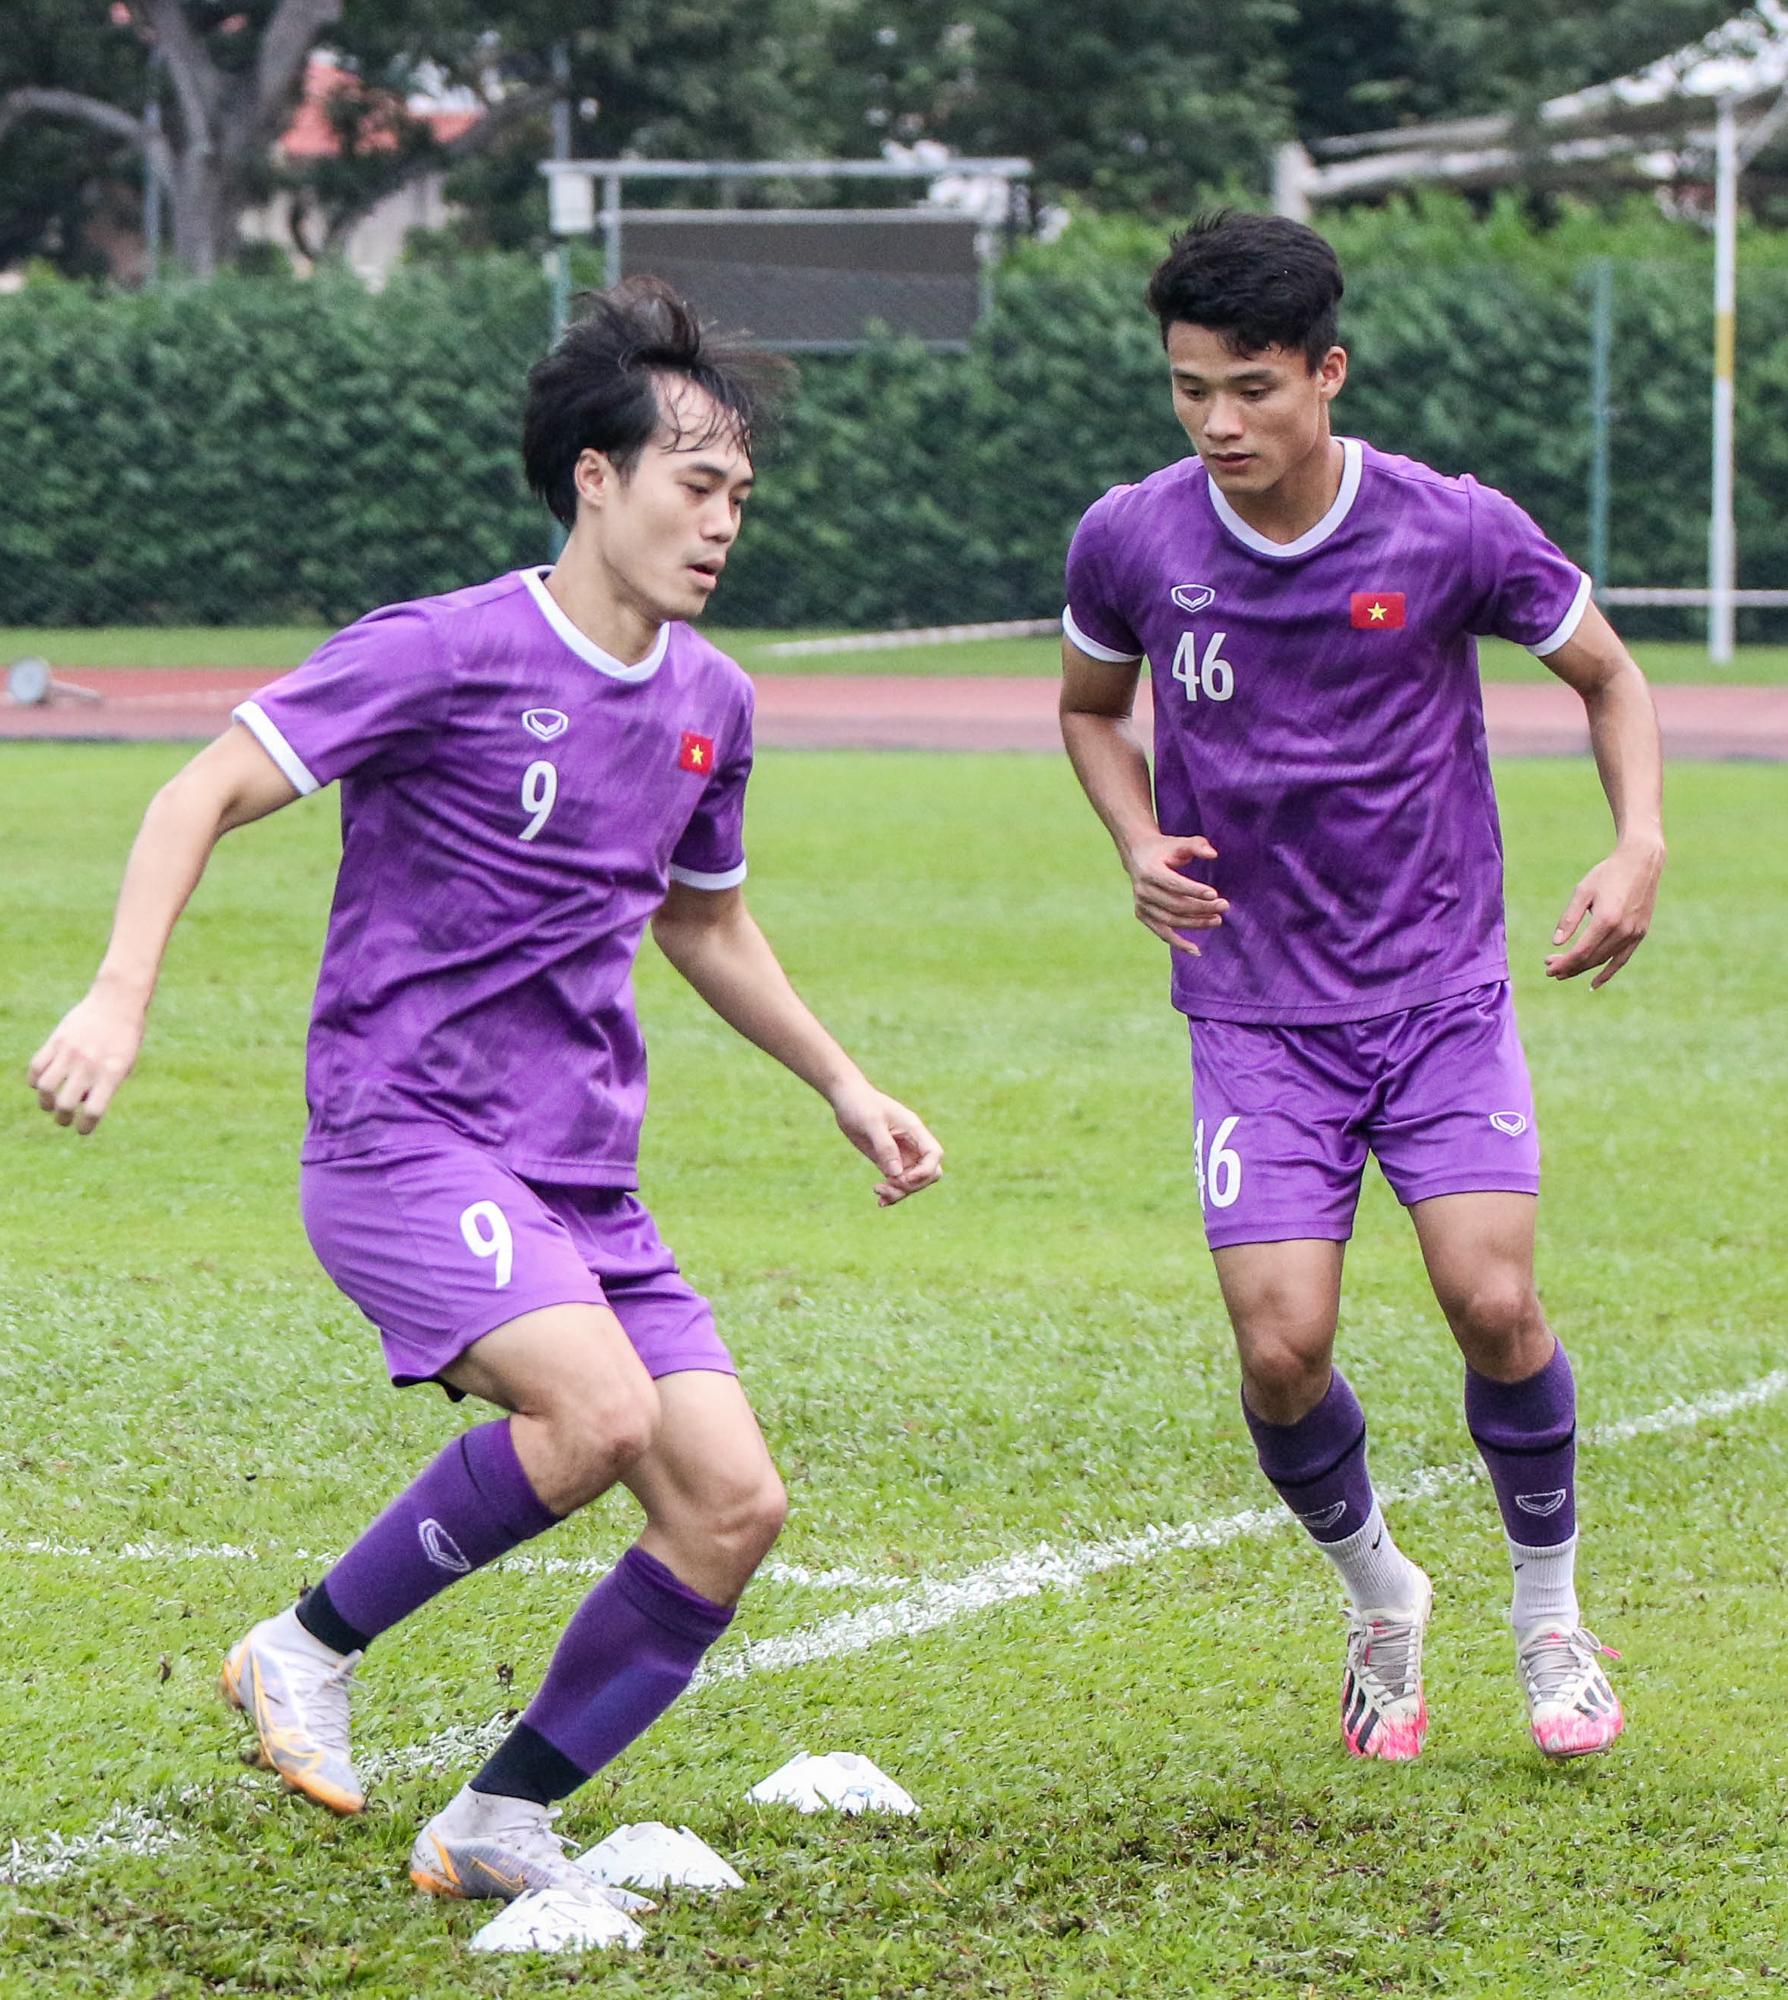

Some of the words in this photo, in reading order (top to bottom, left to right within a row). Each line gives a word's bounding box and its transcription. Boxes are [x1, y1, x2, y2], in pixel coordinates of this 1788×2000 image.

[1171, 631, 1235, 702] 46
[518, 760, 558, 841] 9
[459, 1200, 513, 1289] 9
